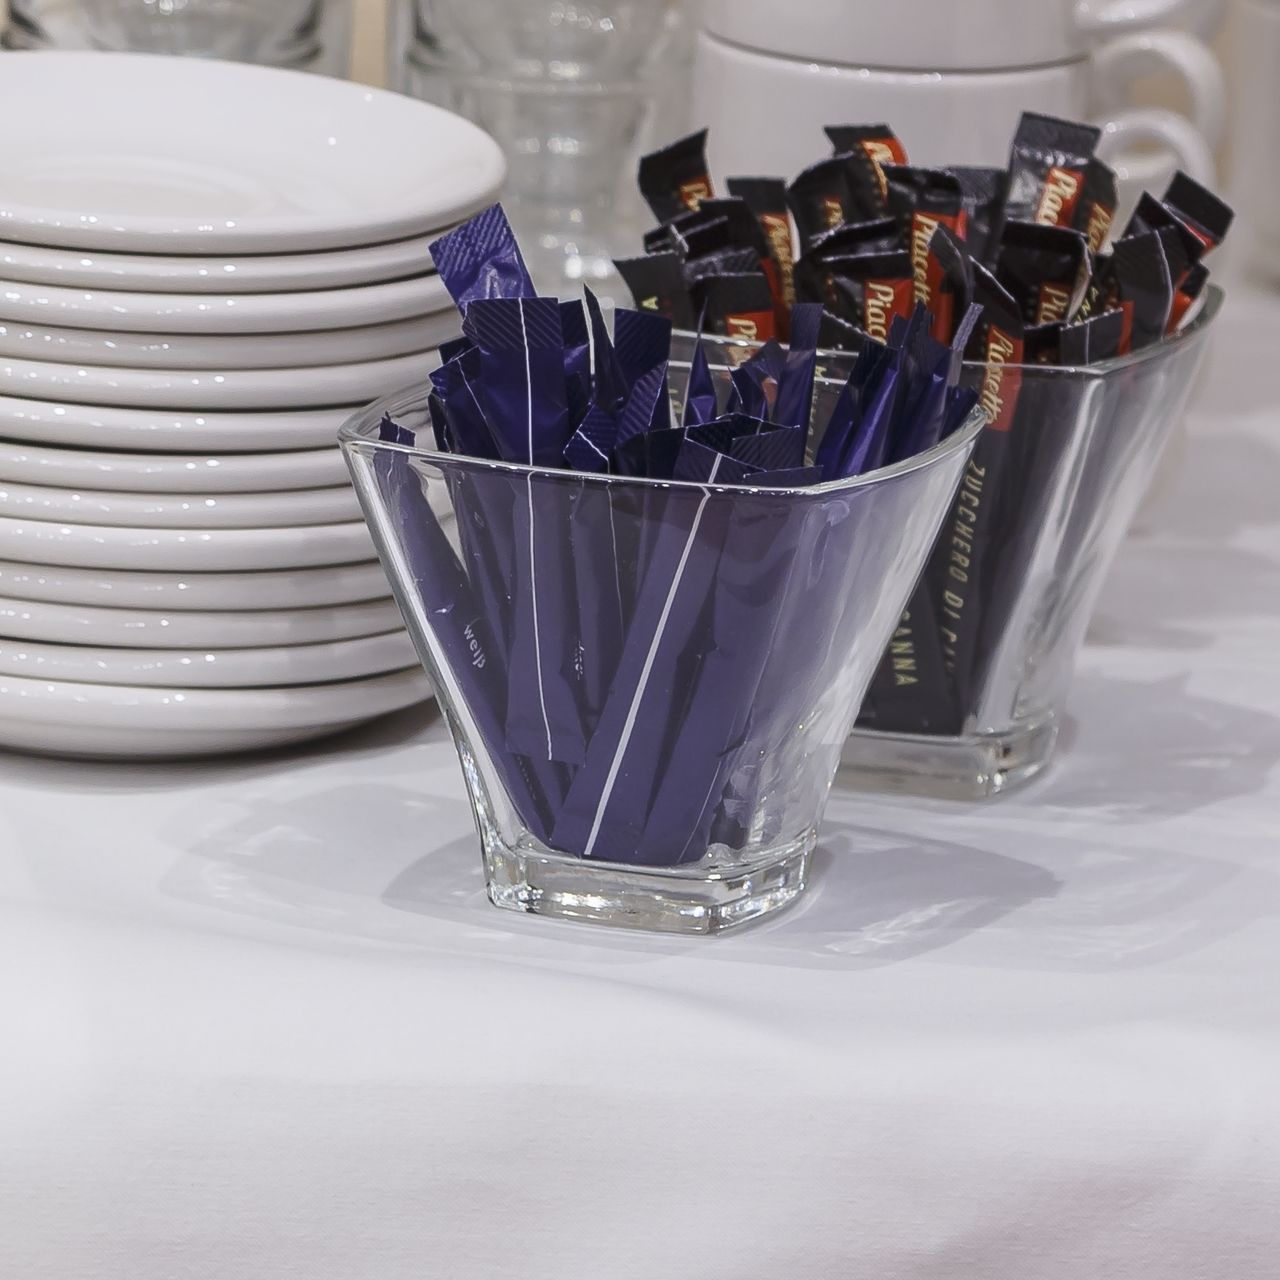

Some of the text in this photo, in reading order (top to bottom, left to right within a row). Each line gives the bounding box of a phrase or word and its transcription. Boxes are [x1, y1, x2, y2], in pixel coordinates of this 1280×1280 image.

[912, 213, 940, 306] Piacett
[865, 281, 895, 347] Piac
[948, 459, 986, 583] ZUCCHERO
